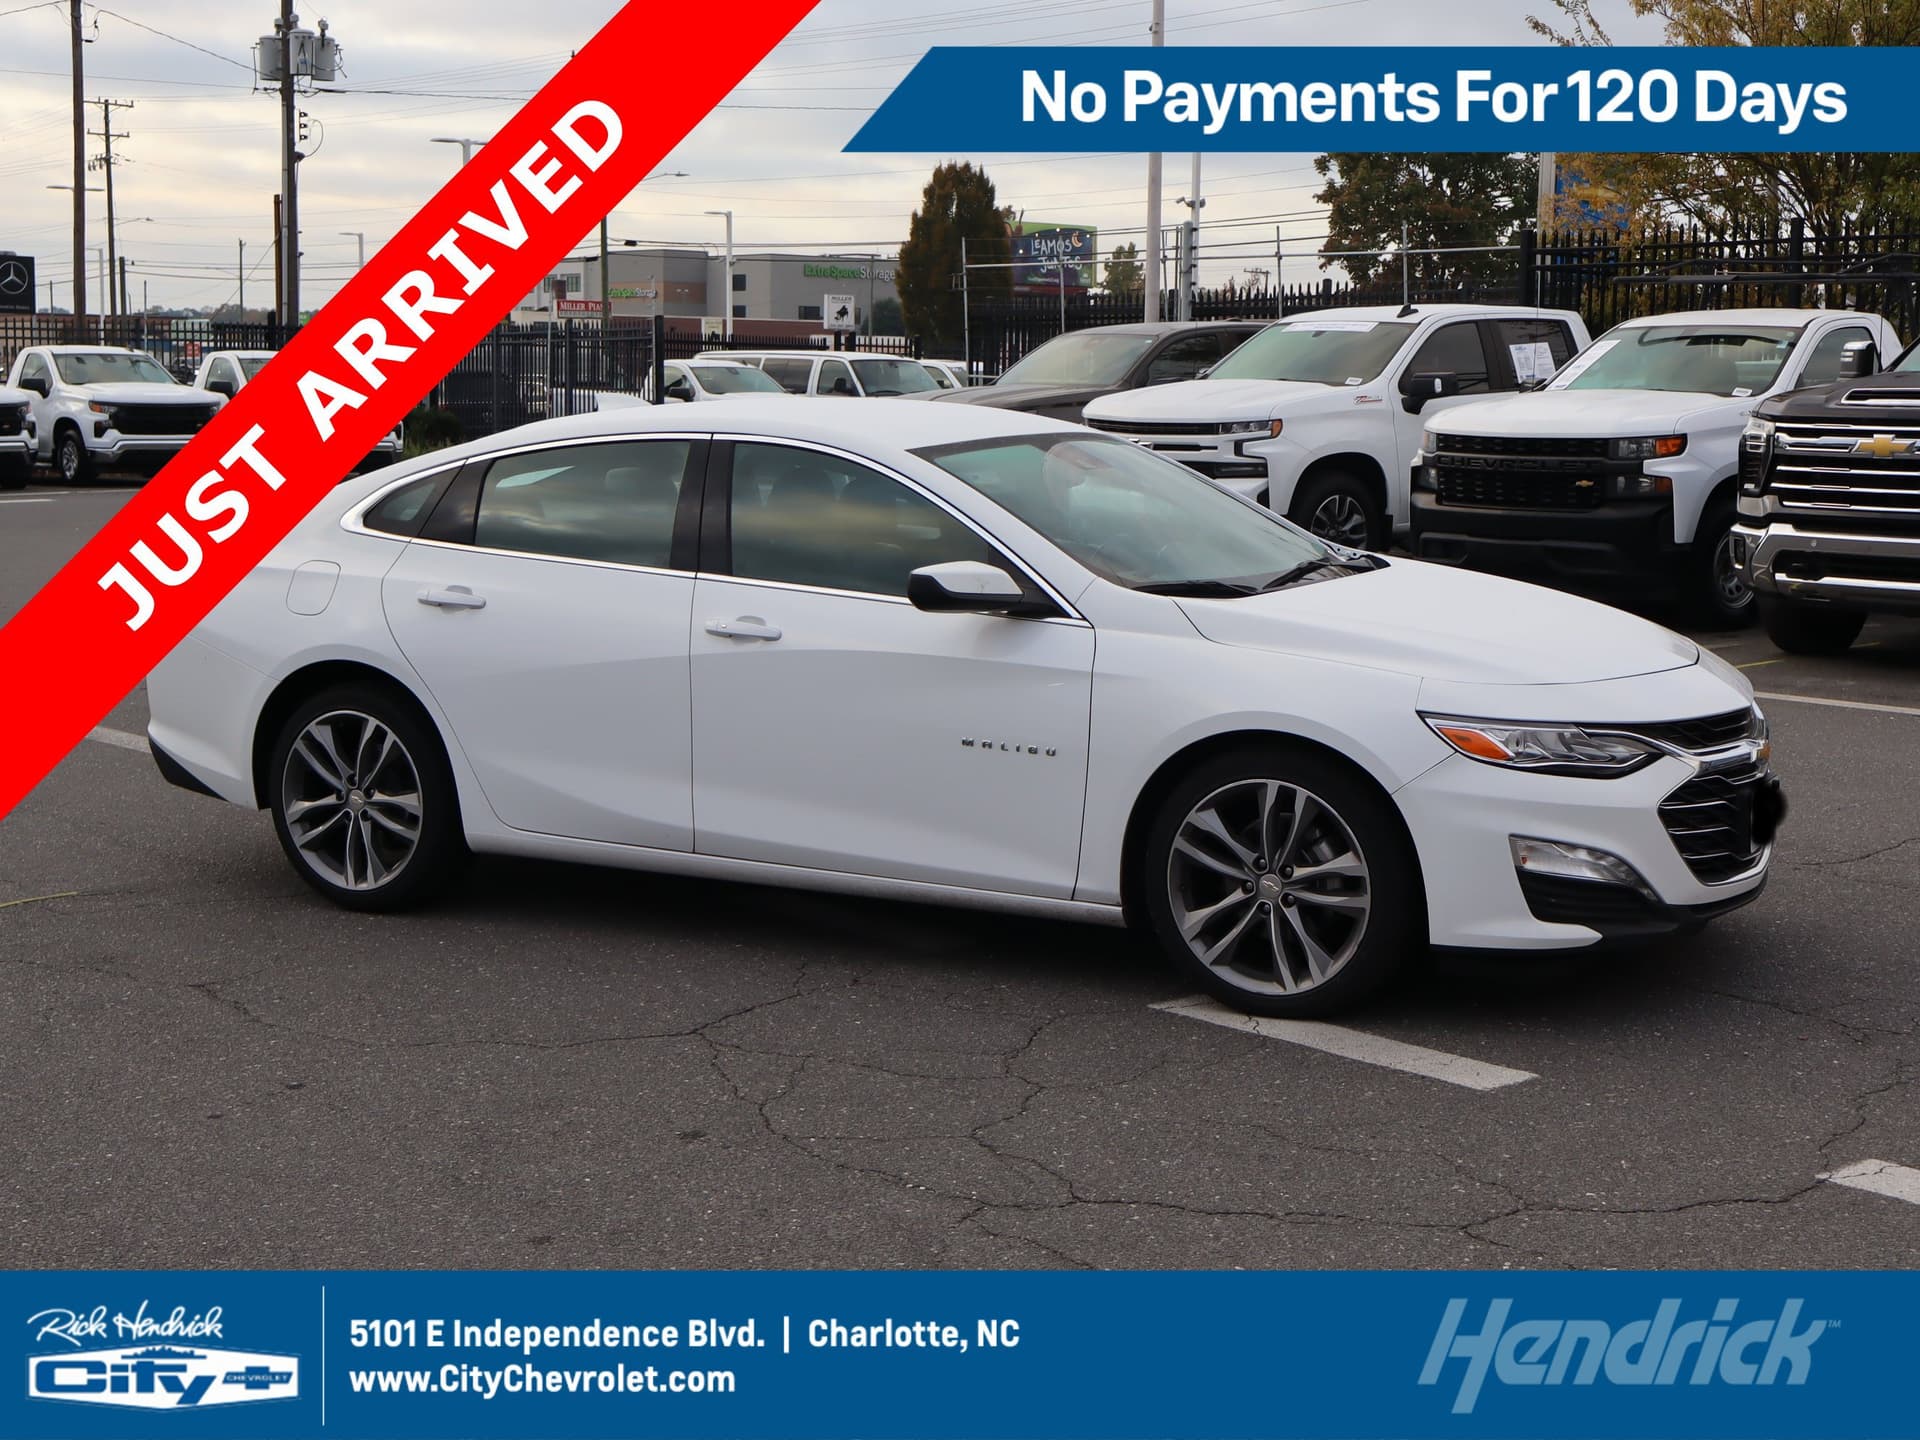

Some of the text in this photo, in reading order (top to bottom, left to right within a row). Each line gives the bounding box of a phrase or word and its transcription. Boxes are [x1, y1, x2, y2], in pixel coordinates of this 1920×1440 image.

[1031, 239, 1073, 256] LEAMOS
[560, 301, 586, 311] MILLER
[961, 737, 1057, 757] MALIBU
